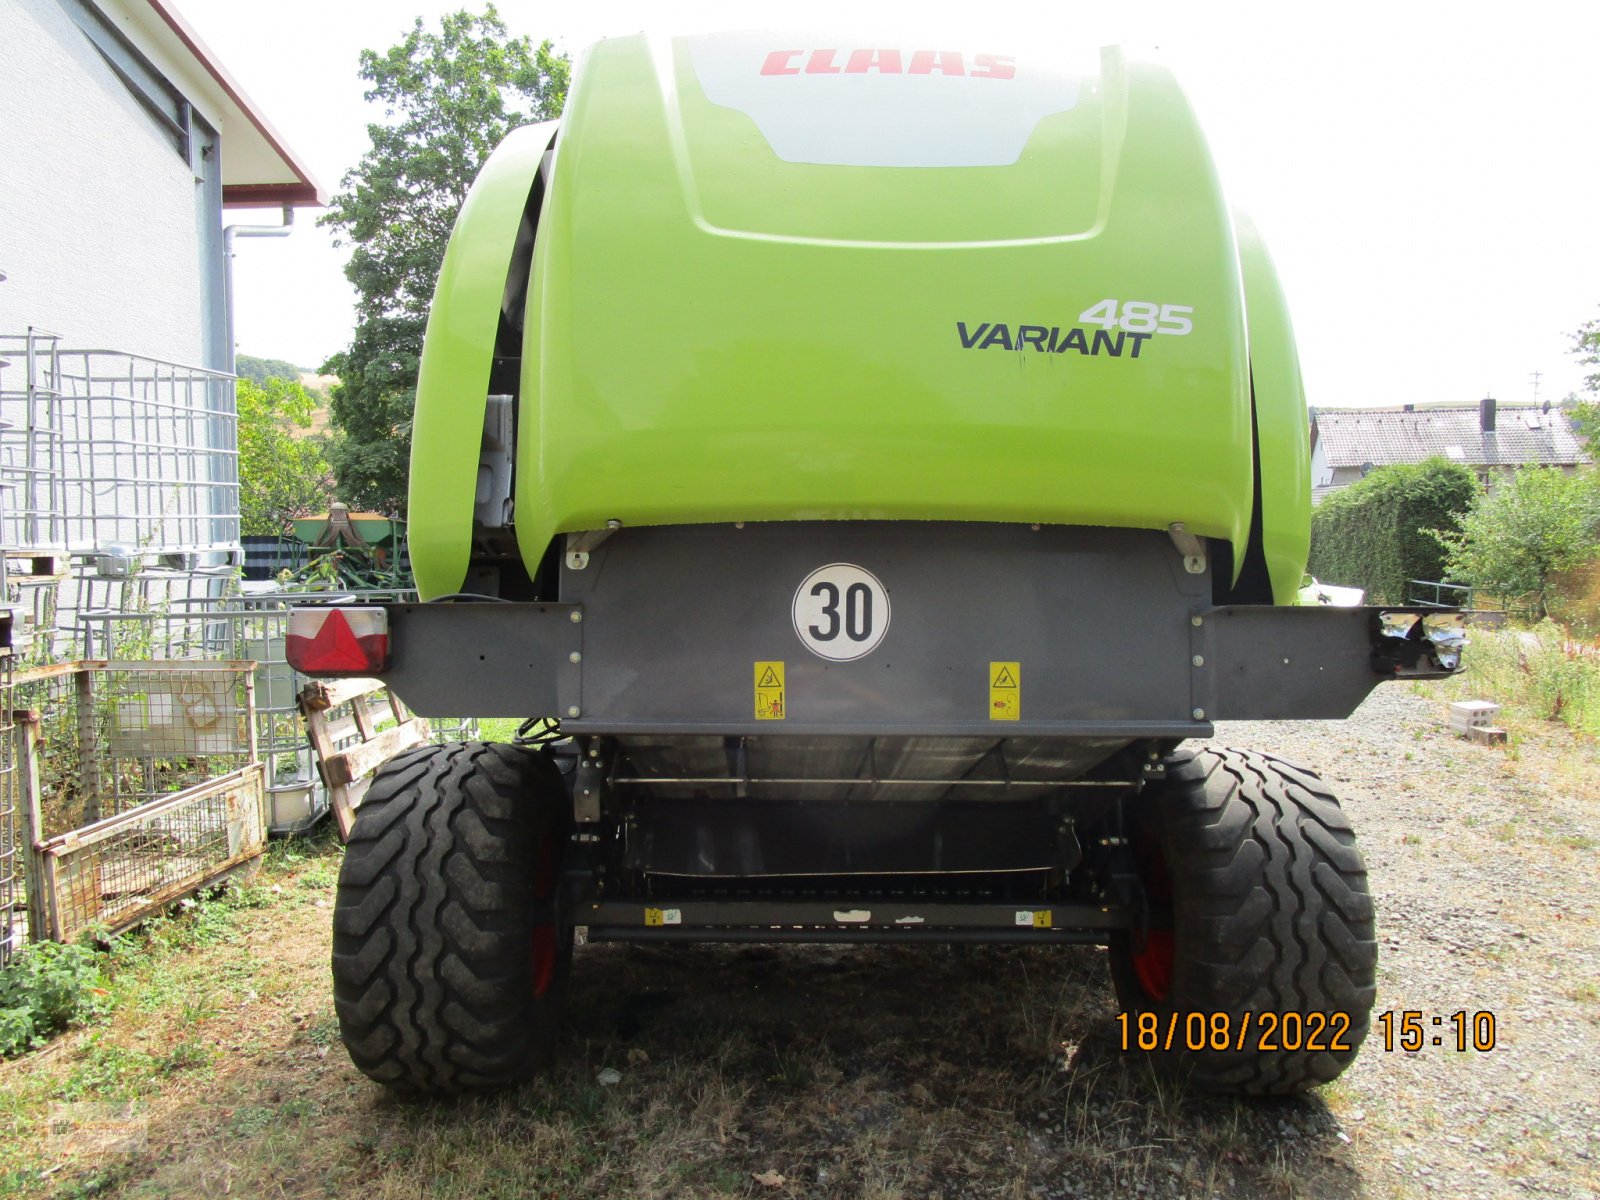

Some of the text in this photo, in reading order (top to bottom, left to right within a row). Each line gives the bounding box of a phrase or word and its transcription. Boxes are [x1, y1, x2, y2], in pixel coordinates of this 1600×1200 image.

[760, 49, 1017, 80] CLAAS
[1078, 299, 1194, 335] 485
[956, 321, 1153, 358] VARIANT
[808, 581, 873, 642] 30
